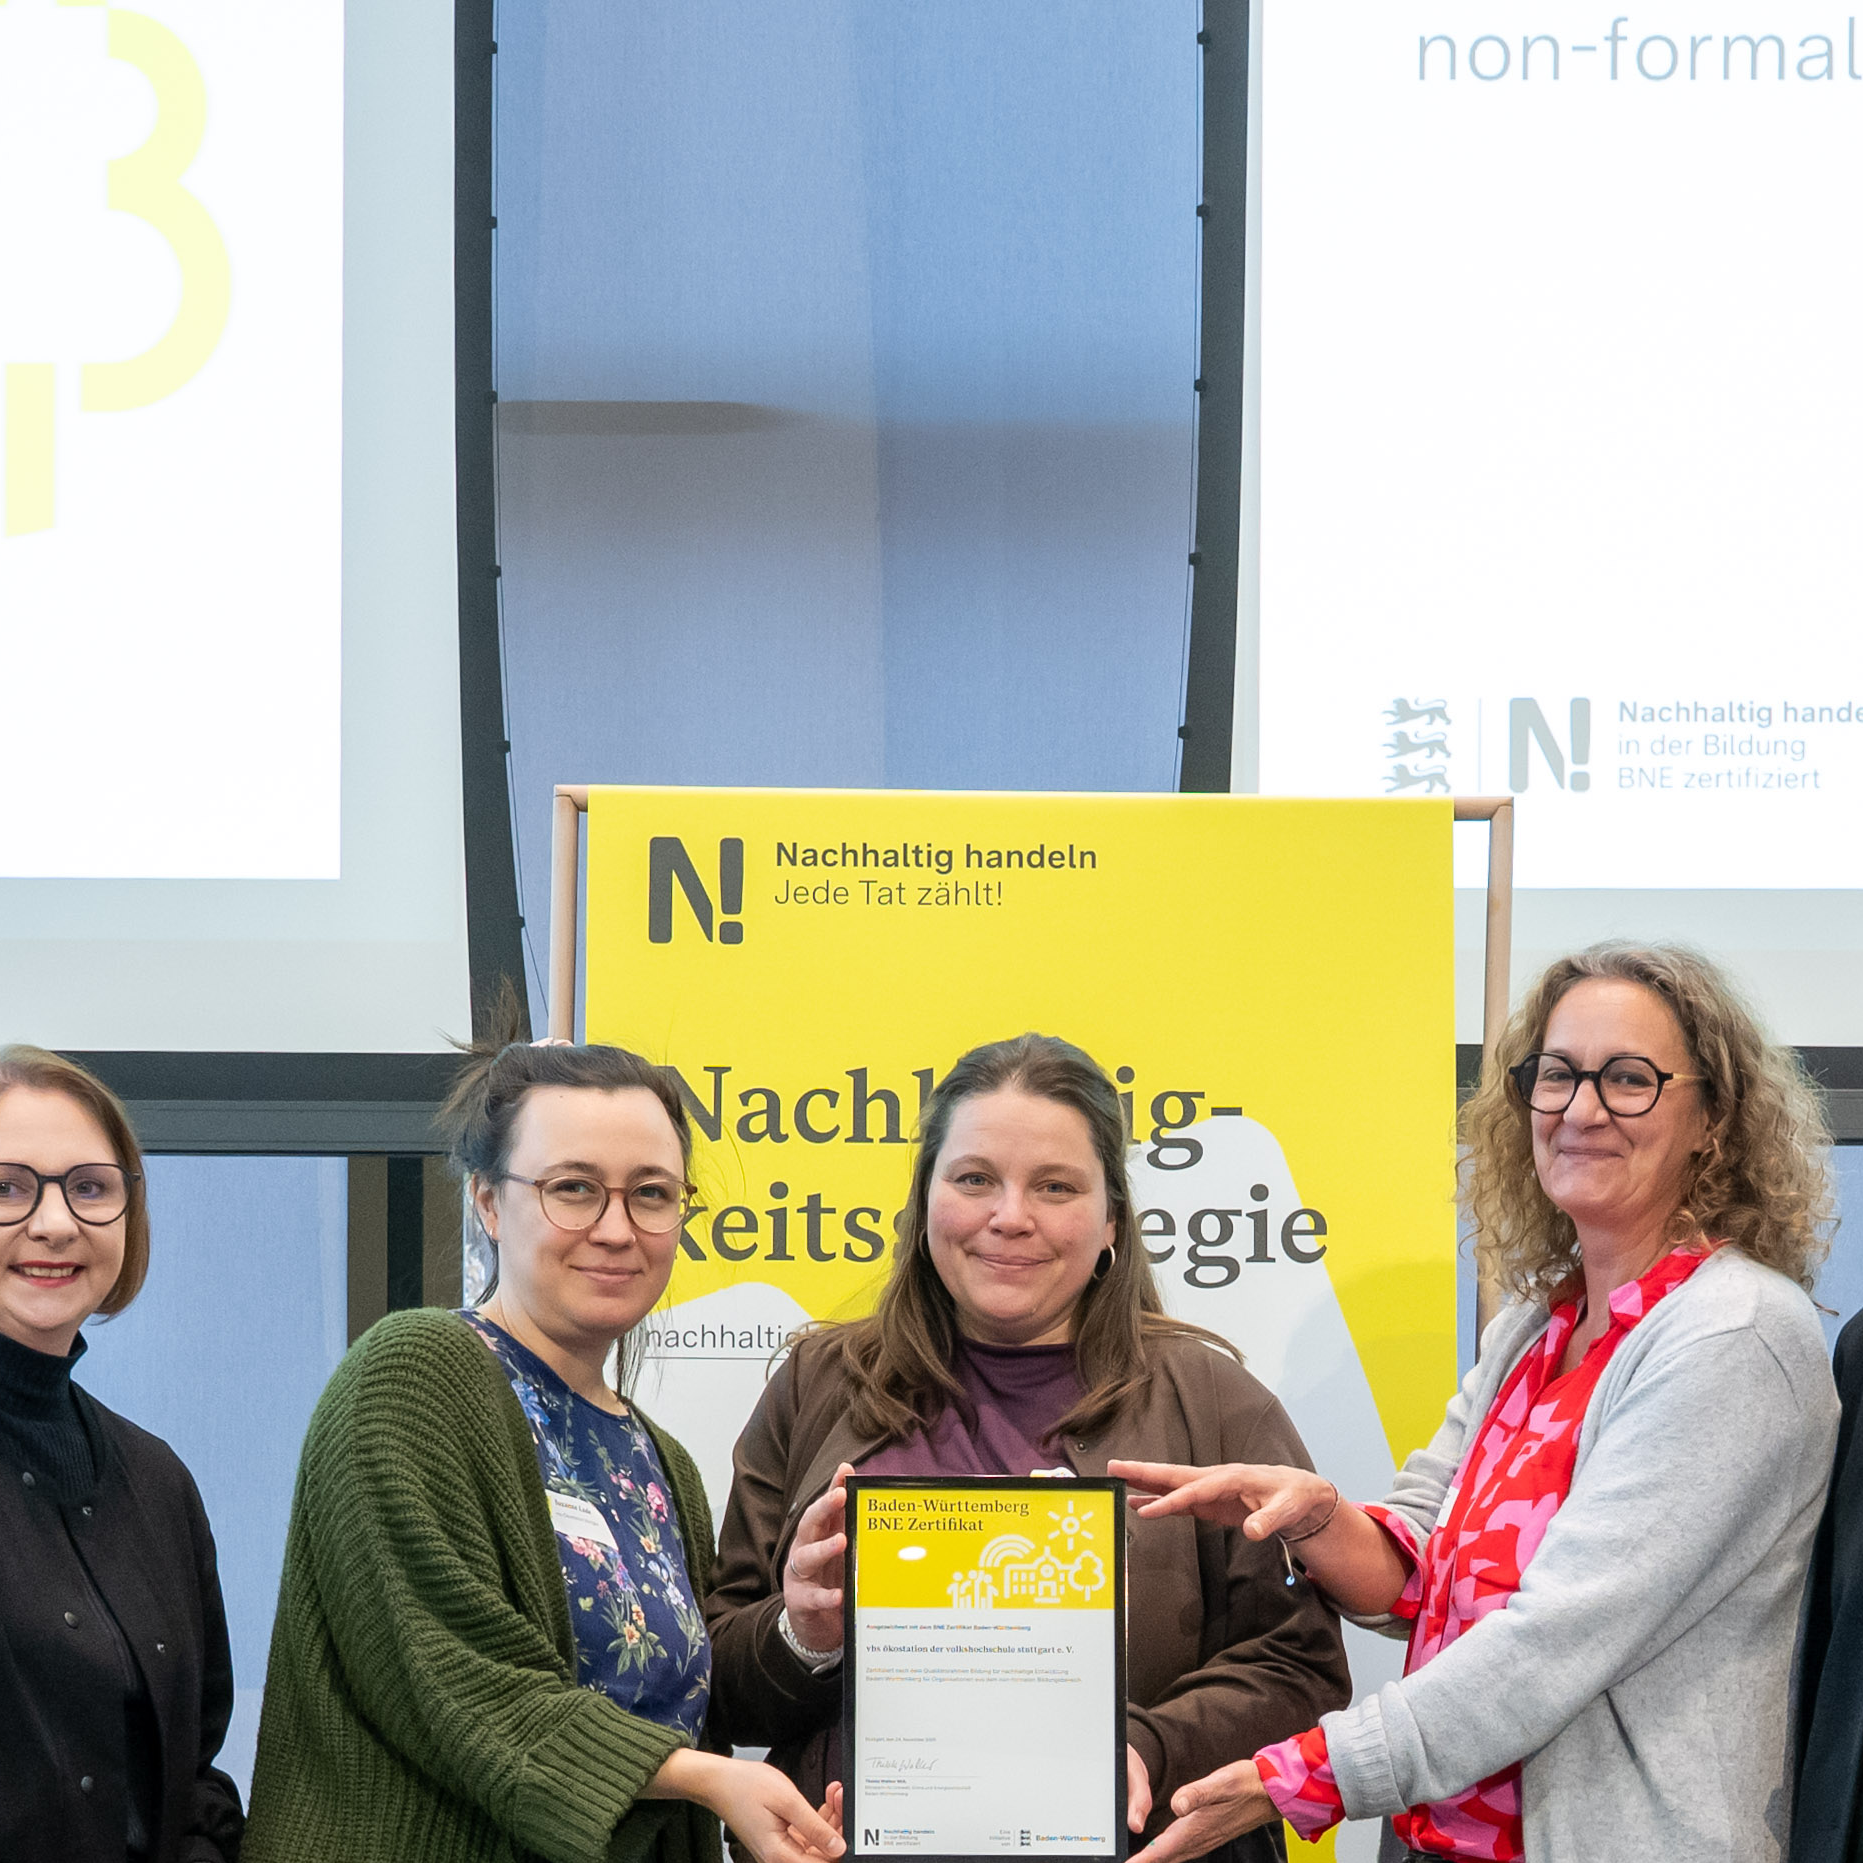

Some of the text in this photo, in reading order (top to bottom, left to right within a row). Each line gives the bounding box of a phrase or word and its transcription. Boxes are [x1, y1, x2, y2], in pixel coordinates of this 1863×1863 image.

[1618, 700, 1773, 729] Nachhaltig
[1508, 696, 1592, 794] N!
[1618, 735, 1806, 762] in der Bildung
[1617, 767, 1821, 790] BNE zertifiziert
[775, 841, 1098, 875] Nachhaltig handeln
[648, 836, 744, 945] N!
[774, 879, 1003, 906] Jede Tat zählt!
[867, 1497, 1030, 1517] Baden-Württemberg
[867, 1517, 984, 1532] BNE Zertifikat
[930, 1645, 944, 1653] der
[1035, 1834, 1107, 1844] Baden-Württemberg
